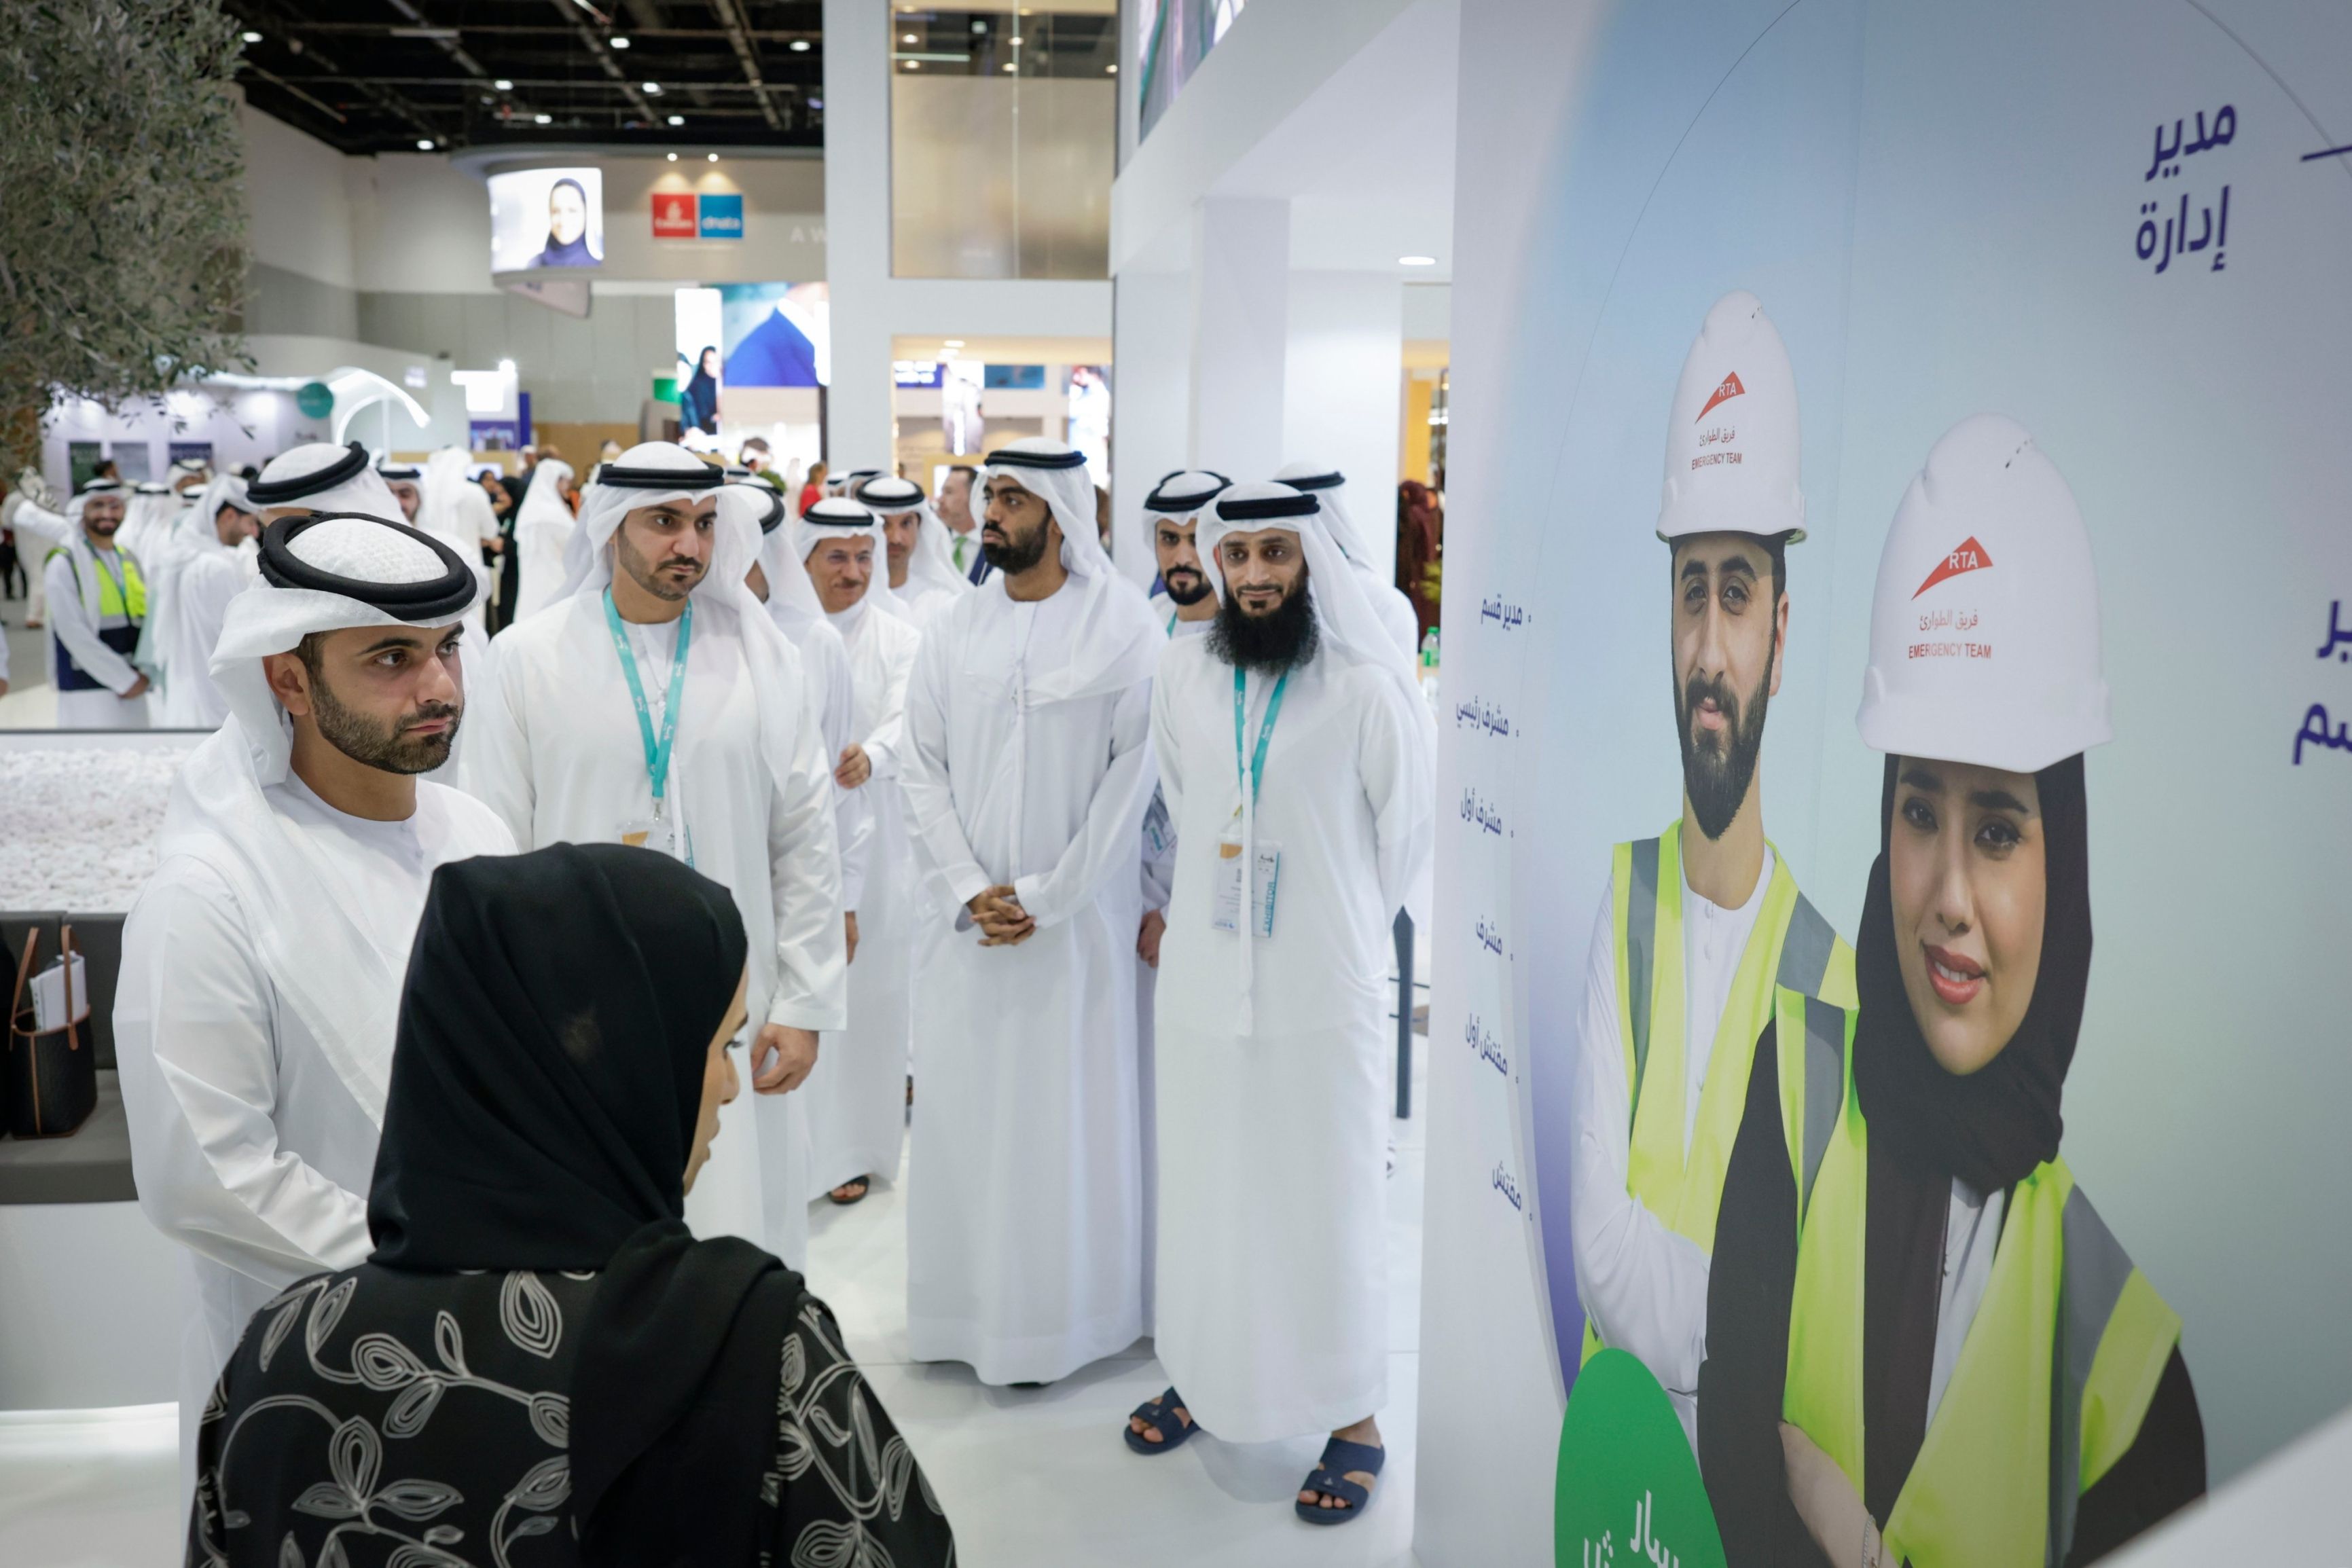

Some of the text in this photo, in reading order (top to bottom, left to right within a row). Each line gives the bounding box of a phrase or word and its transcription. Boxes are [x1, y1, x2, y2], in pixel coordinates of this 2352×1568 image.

[2144, 103, 2237, 181] مدير
[2135, 185, 2231, 274] إدارة
[1718, 382, 1737, 397] RTA
[1720, 425, 1735, 443] فريق
[1692, 452, 1742, 470] EMERGENCY TEAM
[1949, 550, 1978, 569] RTA
[1481, 593, 1522, 632] مدير قسم
[1919, 608, 1978, 631] فريق الطوارئ
[1908, 642, 1991, 659] EMERGENCY TEAM
[1456, 695, 1508, 737] مشرف رئيسي
[1460, 787, 1502, 836] مشرف أول
[1476, 914, 1502, 955] مشرف
[1465, 1013, 1508, 1076] مفتش أول
[1492, 1160, 1521, 1211] مفتش
